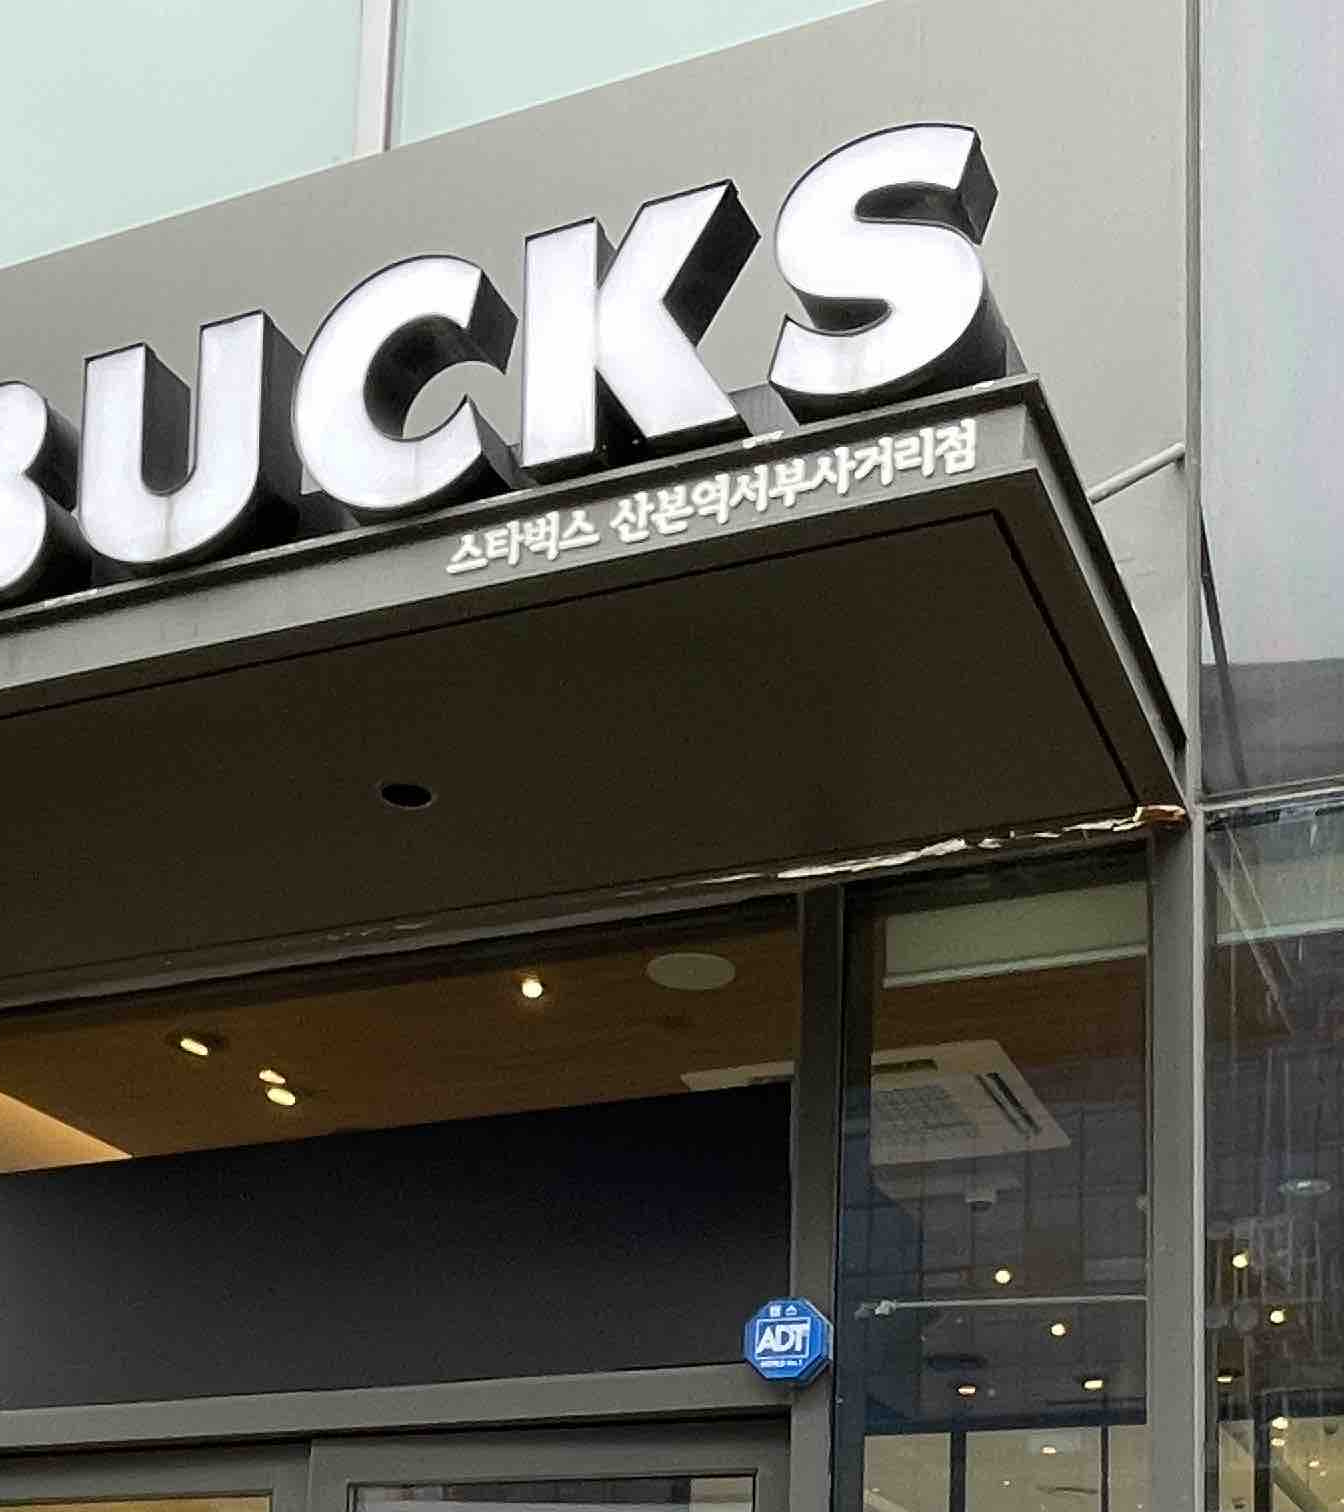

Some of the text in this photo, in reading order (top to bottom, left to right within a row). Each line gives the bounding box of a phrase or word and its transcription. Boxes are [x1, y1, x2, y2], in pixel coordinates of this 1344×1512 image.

[446, 419, 977, 573] 스타벅스 산본역서부사거리점
[756, 1322, 809, 1354] ADT
